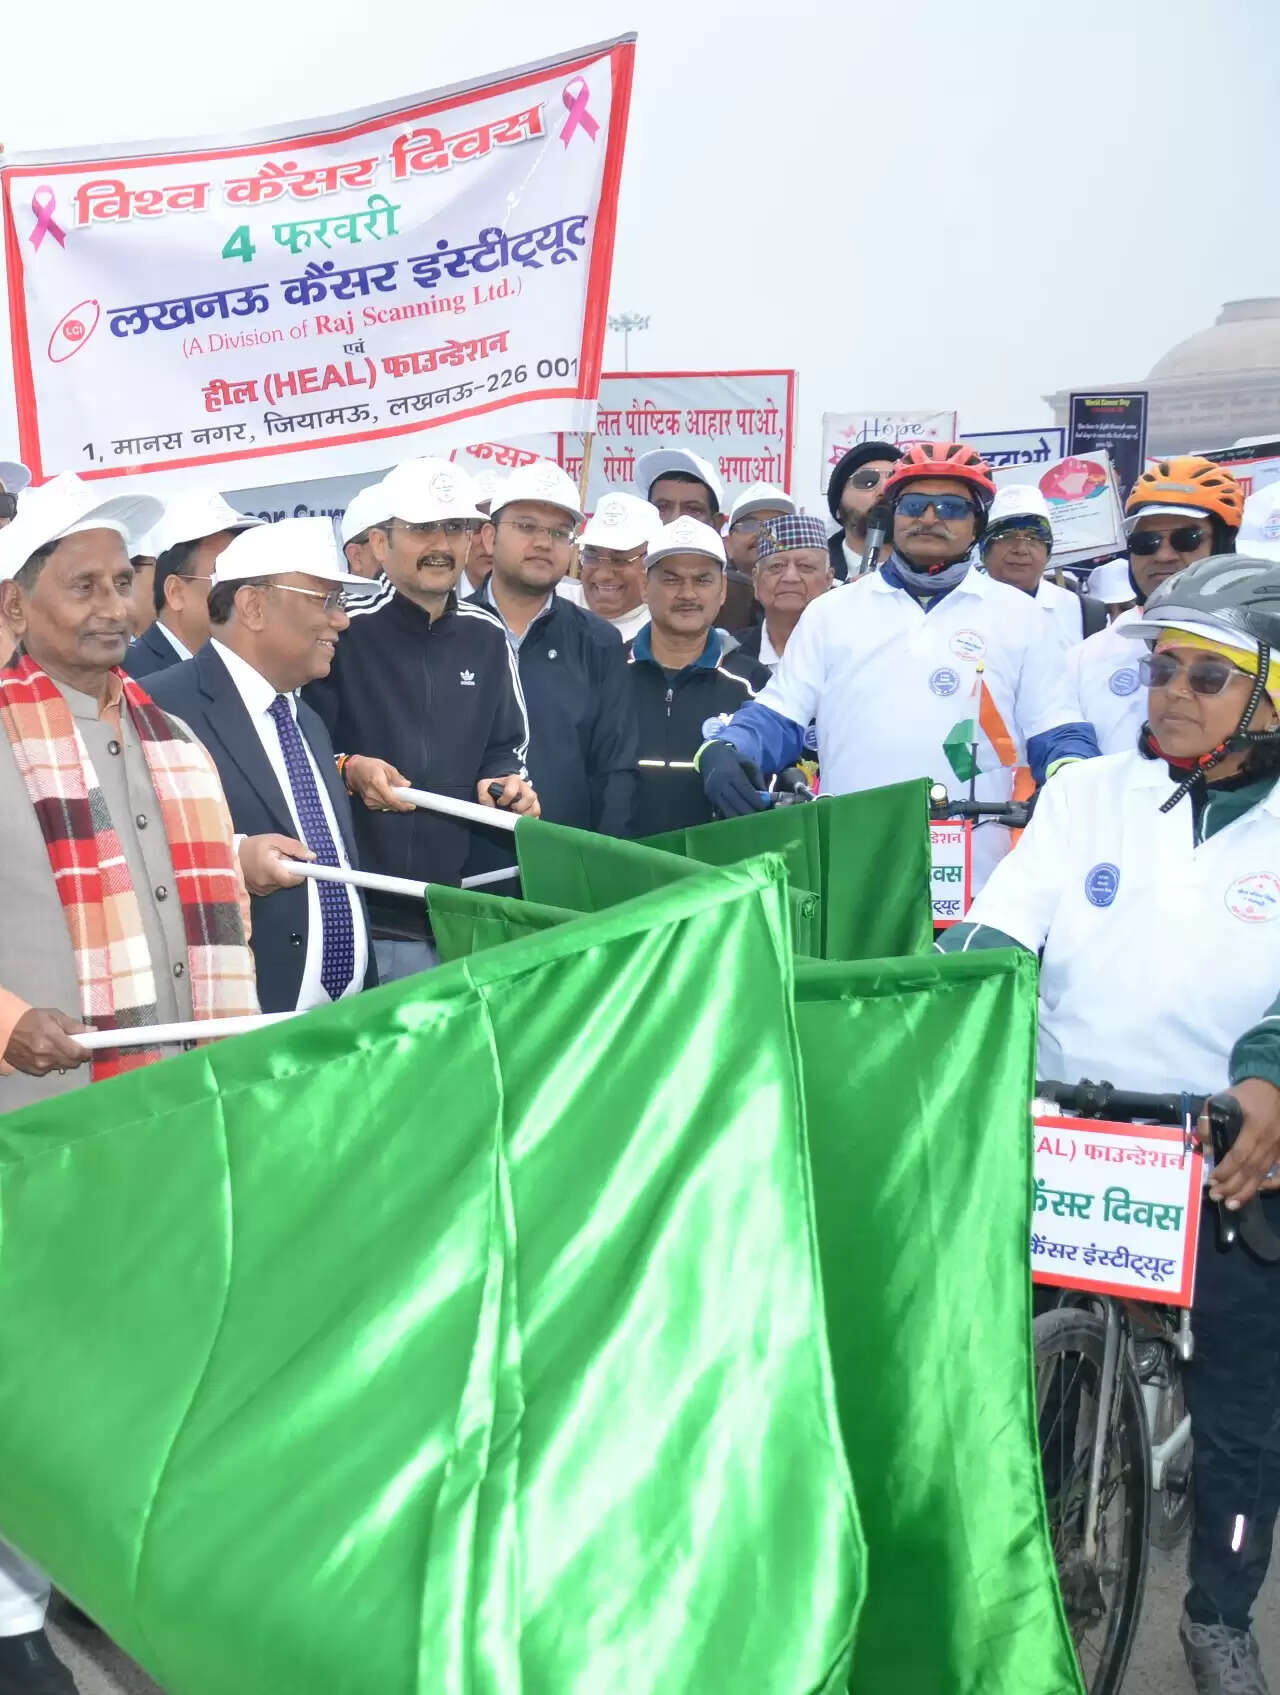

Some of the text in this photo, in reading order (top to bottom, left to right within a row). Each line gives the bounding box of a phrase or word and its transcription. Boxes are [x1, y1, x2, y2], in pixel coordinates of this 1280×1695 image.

[74, 101, 545, 225] विश्व कैंसर दिवस
[221, 194, 401, 263] 4 फरवरी
[106, 283, 269, 338] लखनऊ
[280, 260, 399, 306] कैंसर
[182, 275, 522, 358] (A Division of Raj Scanning Ltd.)
[201, 329, 510, 413] हील (HEAL) फाउन्डेशन
[342, 338, 366, 355] एवं
[82, 442, 104, 463] 1,
[111, 431, 183, 456] मानस
[190, 421, 256, 443] नगर,
[263, 403, 379, 437] जियामऊ,
[535, 356, 578, 379] 001
[625, 398, 682, 437] पौष्टिक
[687, 407, 733, 442] आहार
[736, 397, 784, 442] पाओ,
[856, 418, 926, 444] Hope
[1035, 1136, 1185, 1171] AL) फाउन्डेशन
[1102, 1186, 1184, 1232] दिवस
